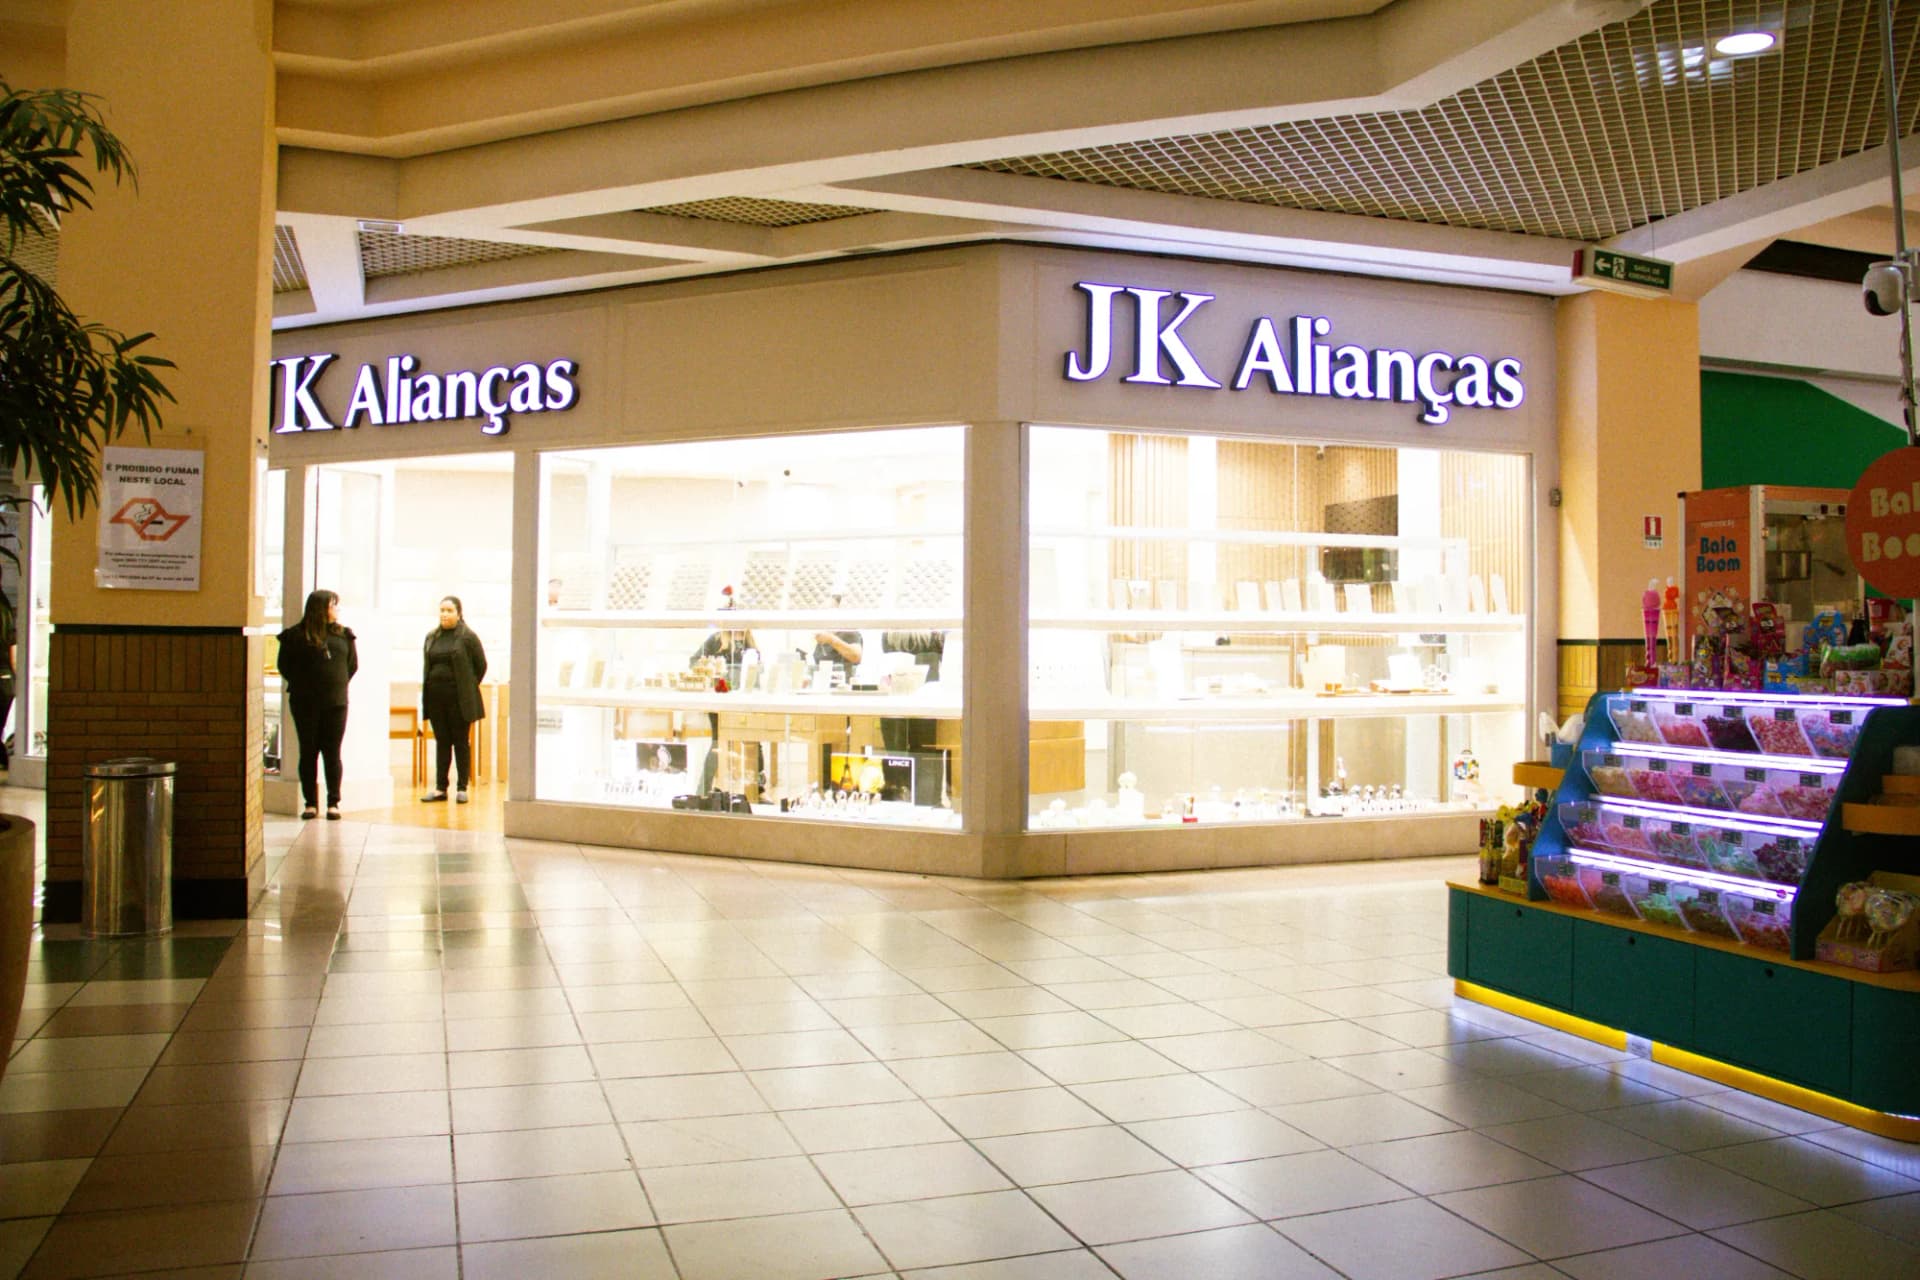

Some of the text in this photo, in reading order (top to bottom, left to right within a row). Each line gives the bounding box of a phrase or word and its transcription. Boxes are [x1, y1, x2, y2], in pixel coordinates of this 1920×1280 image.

[1065, 281, 1525, 425] JK Alianças
[269, 353, 577, 436] K Alianças
[115, 464, 163, 474] PROIBIDO
[165, 466, 200, 475] FUMAR
[119, 476, 186, 486] NESTE LOCAL
[1700, 536, 1736, 554] Bala
[1697, 556, 1741, 573] Boom
